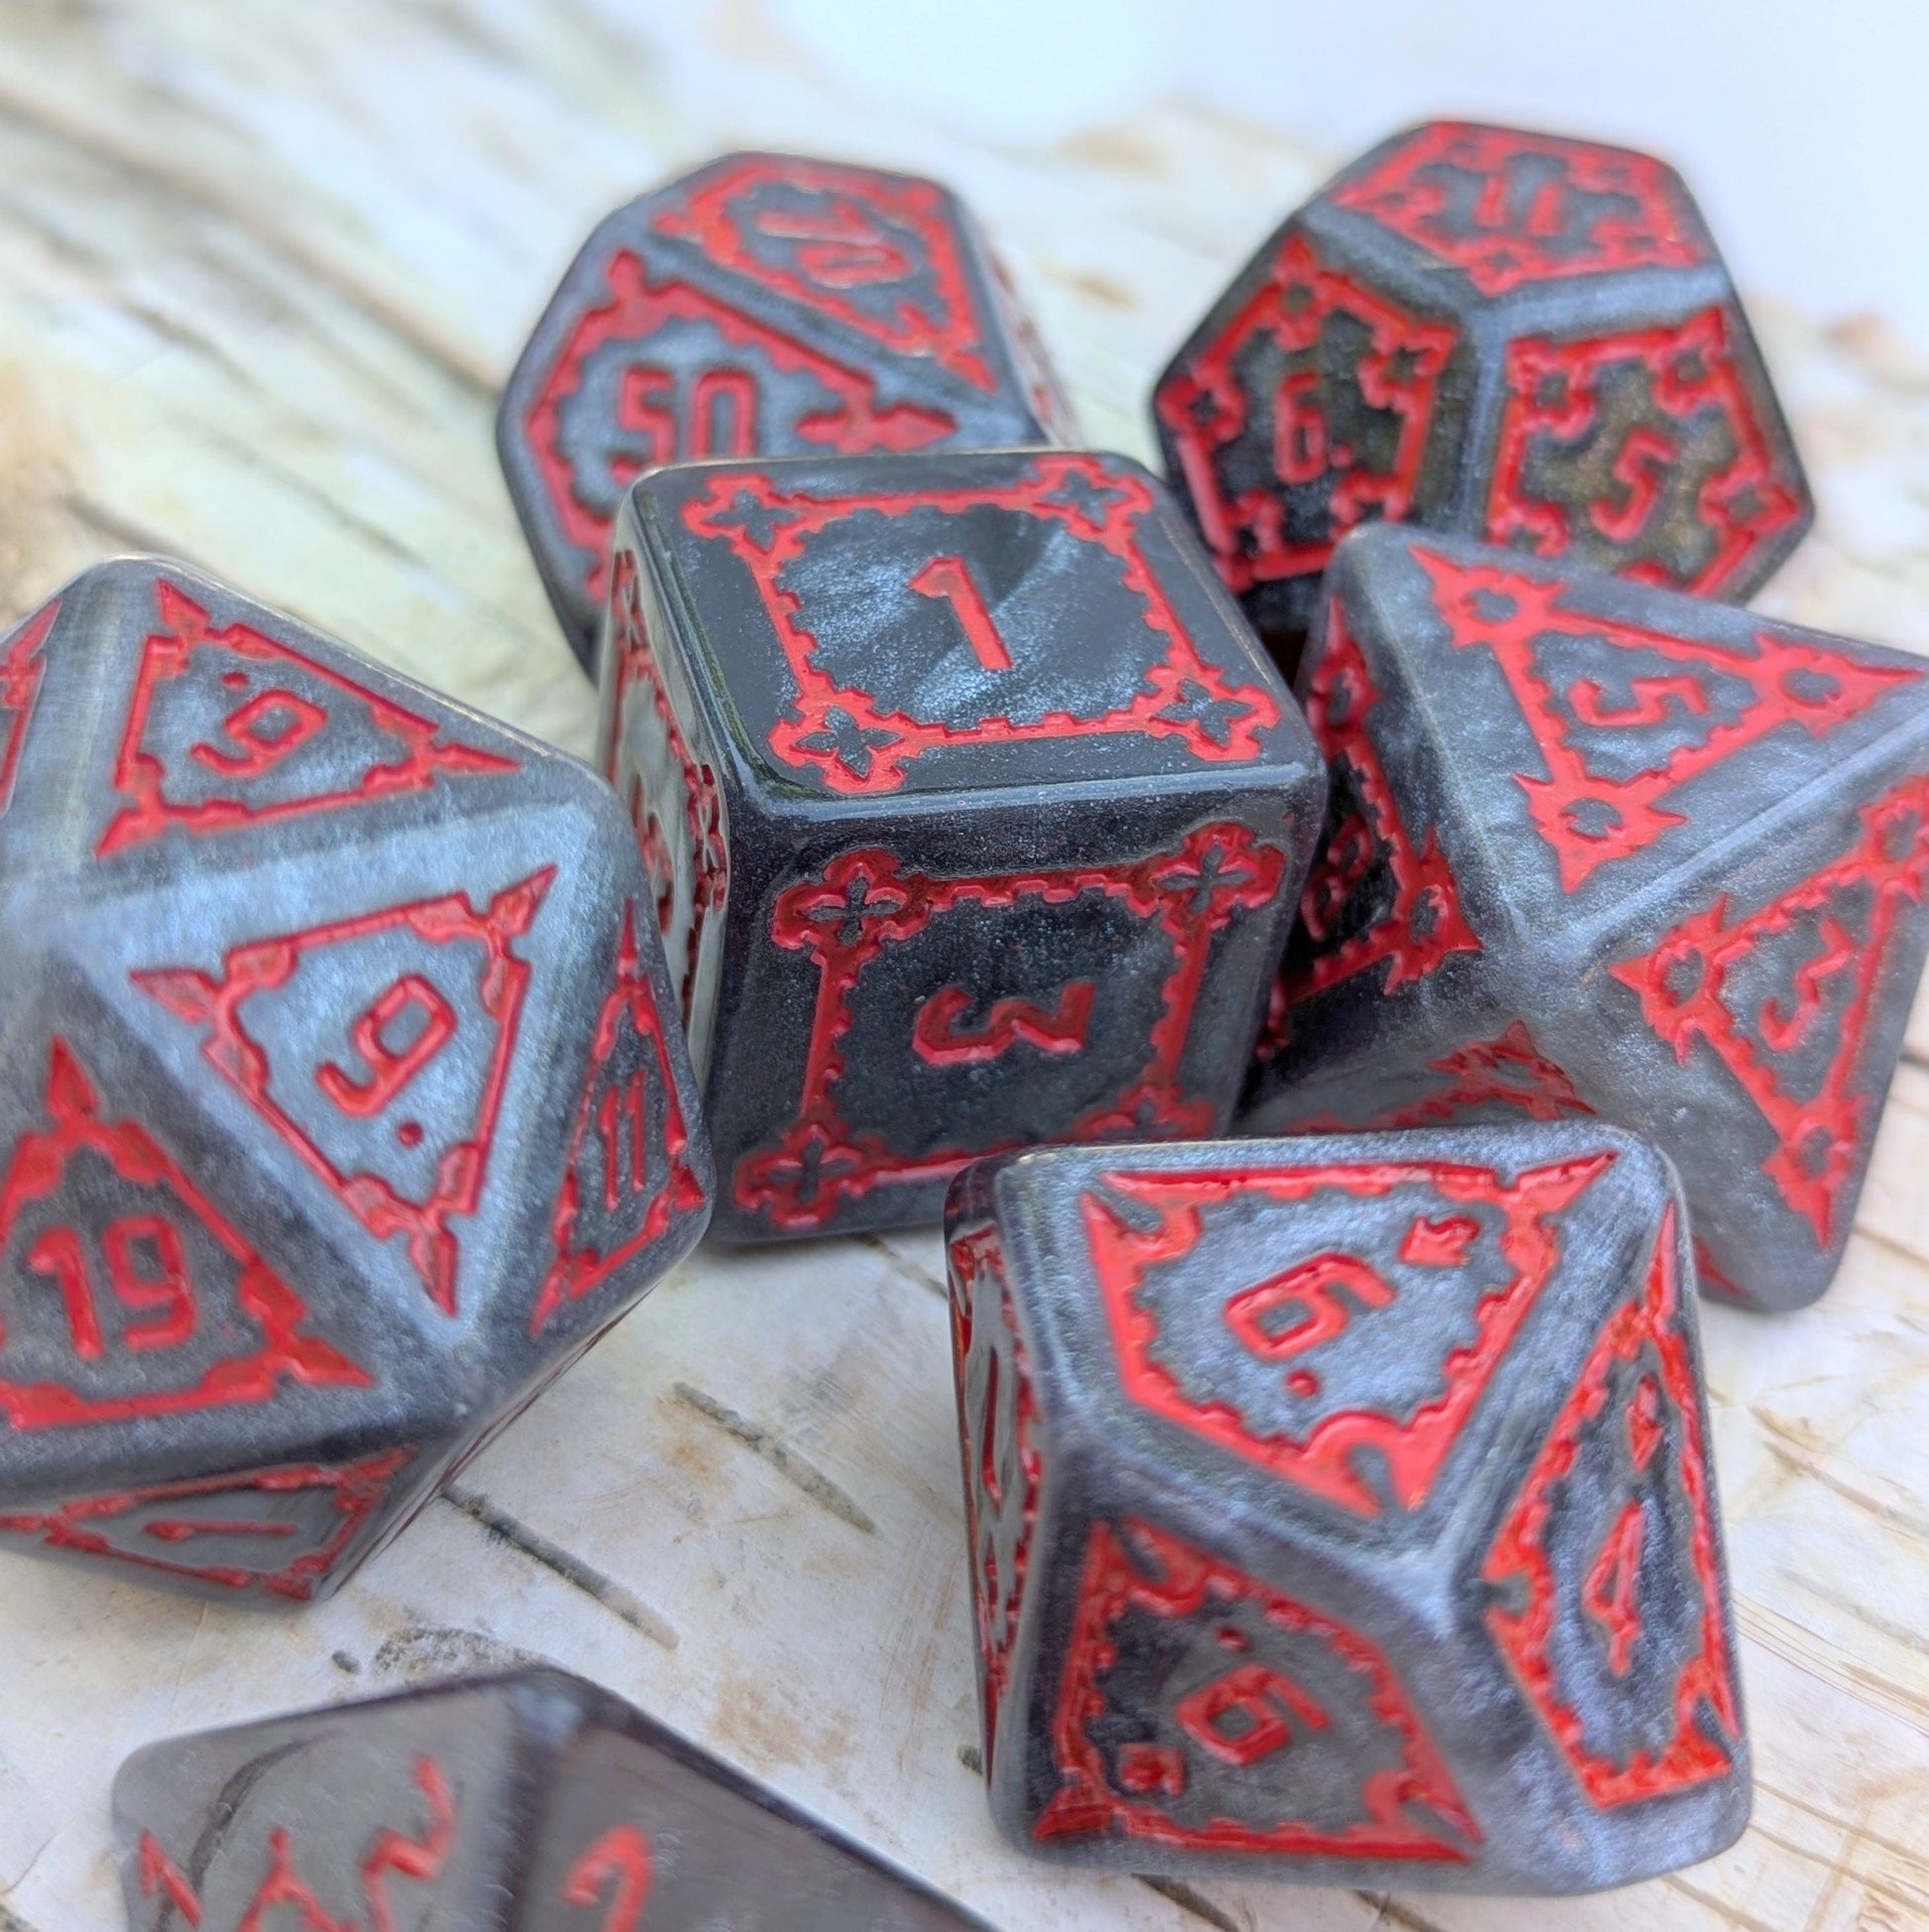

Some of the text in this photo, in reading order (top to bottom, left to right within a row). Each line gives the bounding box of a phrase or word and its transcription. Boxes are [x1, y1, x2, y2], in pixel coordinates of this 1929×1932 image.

[1588, 425, 1678, 542] 5
[910, 555, 1012, 669] 1
[1568, 673, 1710, 729] 5
[912, 982, 1095, 1067] 3
[27, 1212, 198, 1361] 19
[1583, 1501, 1645, 1676] 4
